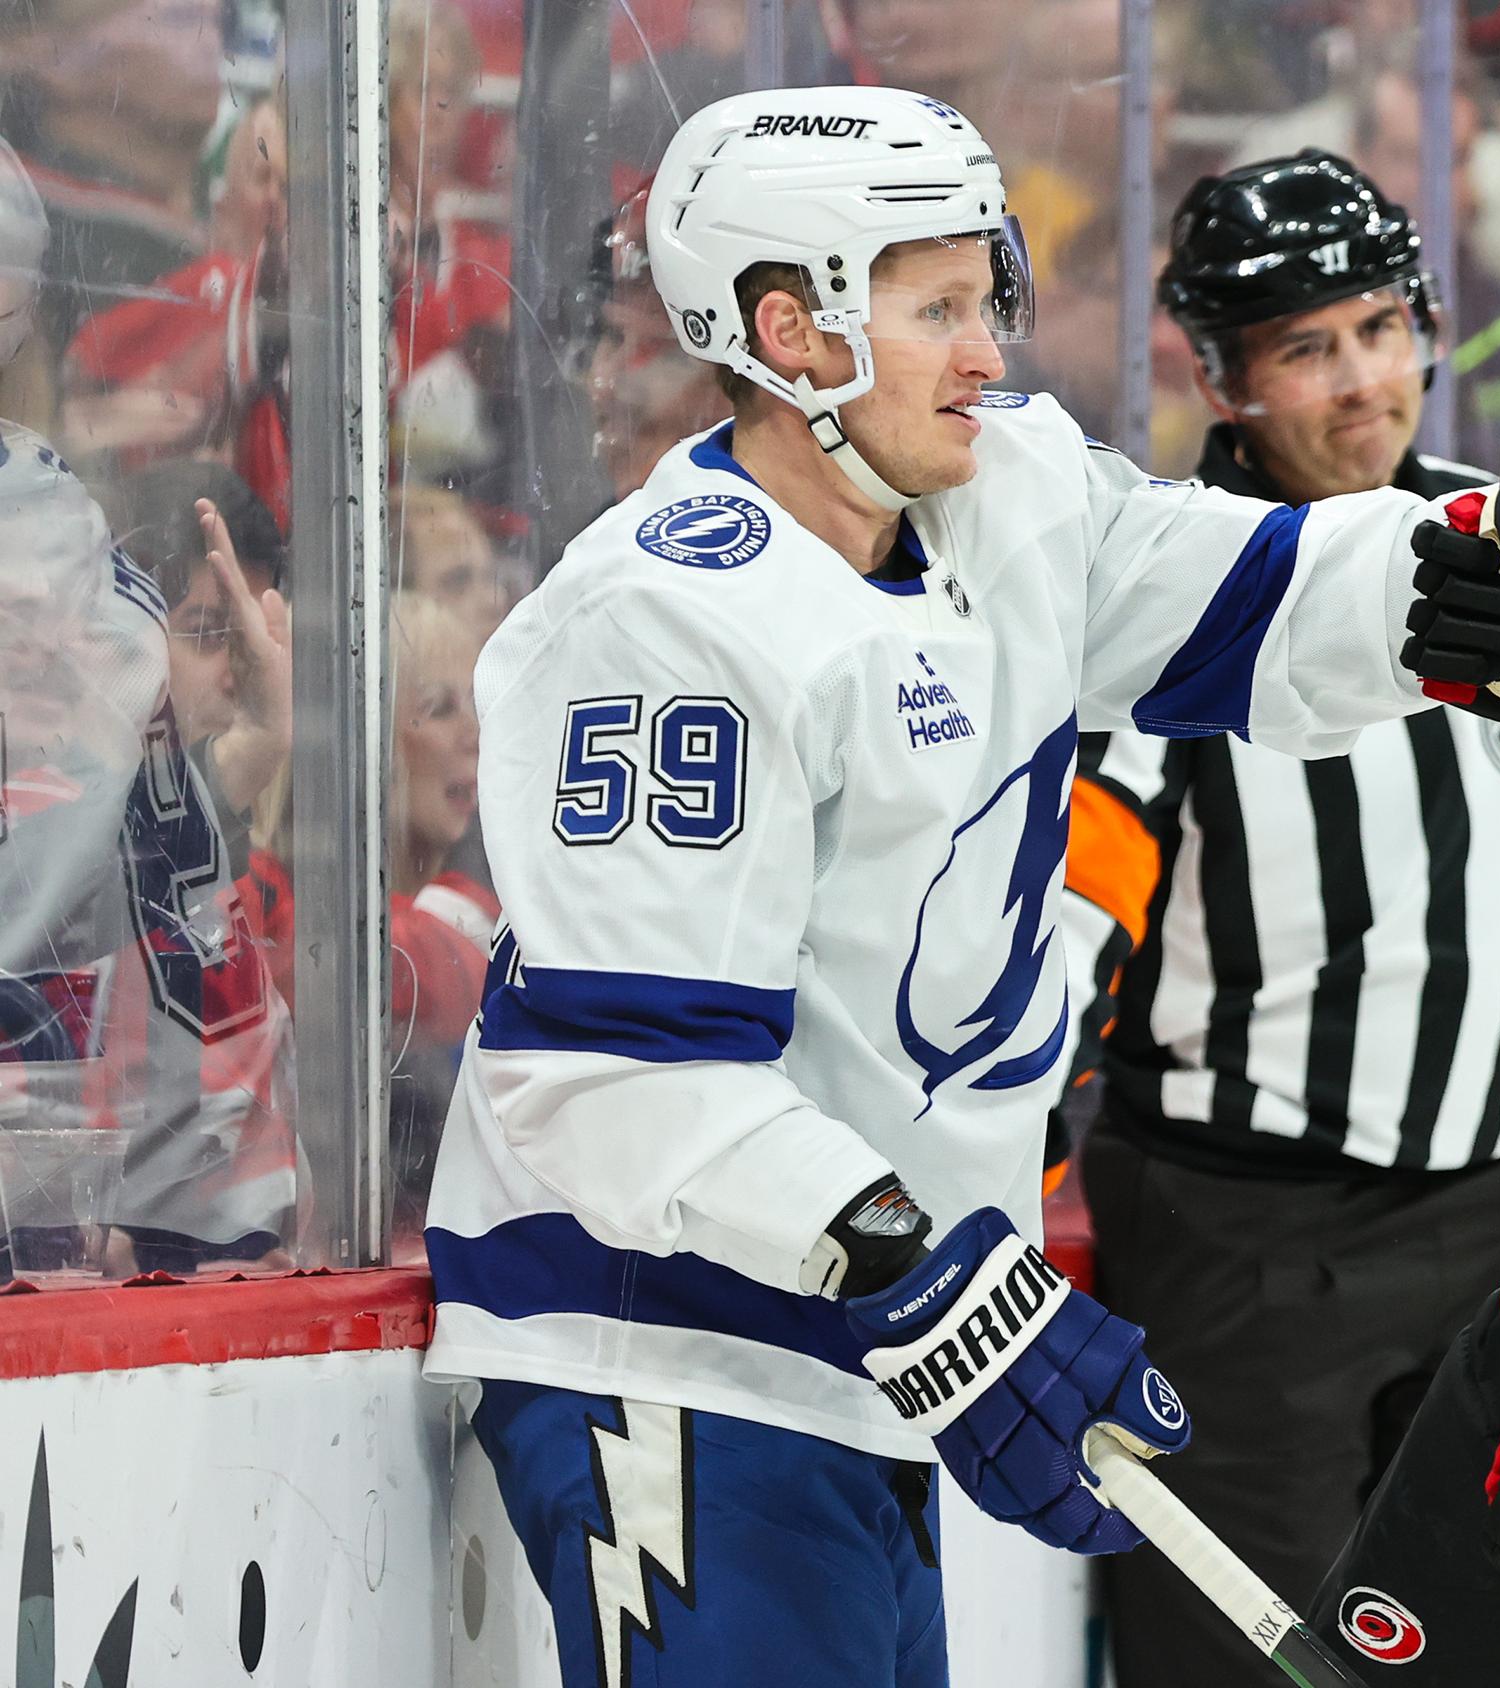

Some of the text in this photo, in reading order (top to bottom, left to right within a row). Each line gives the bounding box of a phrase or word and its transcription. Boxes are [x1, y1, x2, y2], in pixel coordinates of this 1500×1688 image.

[744, 115, 878, 139] BRANDT
[640, 496, 768, 566] TAMPA BAY LIGHTNING
[897, 679, 959, 714] Adven
[907, 709, 976, 749] Health
[552, 694, 750, 851] 59
[887, 1263, 962, 1323] GUENTZEL
[876, 1243, 1067, 1420] WARRIOR
